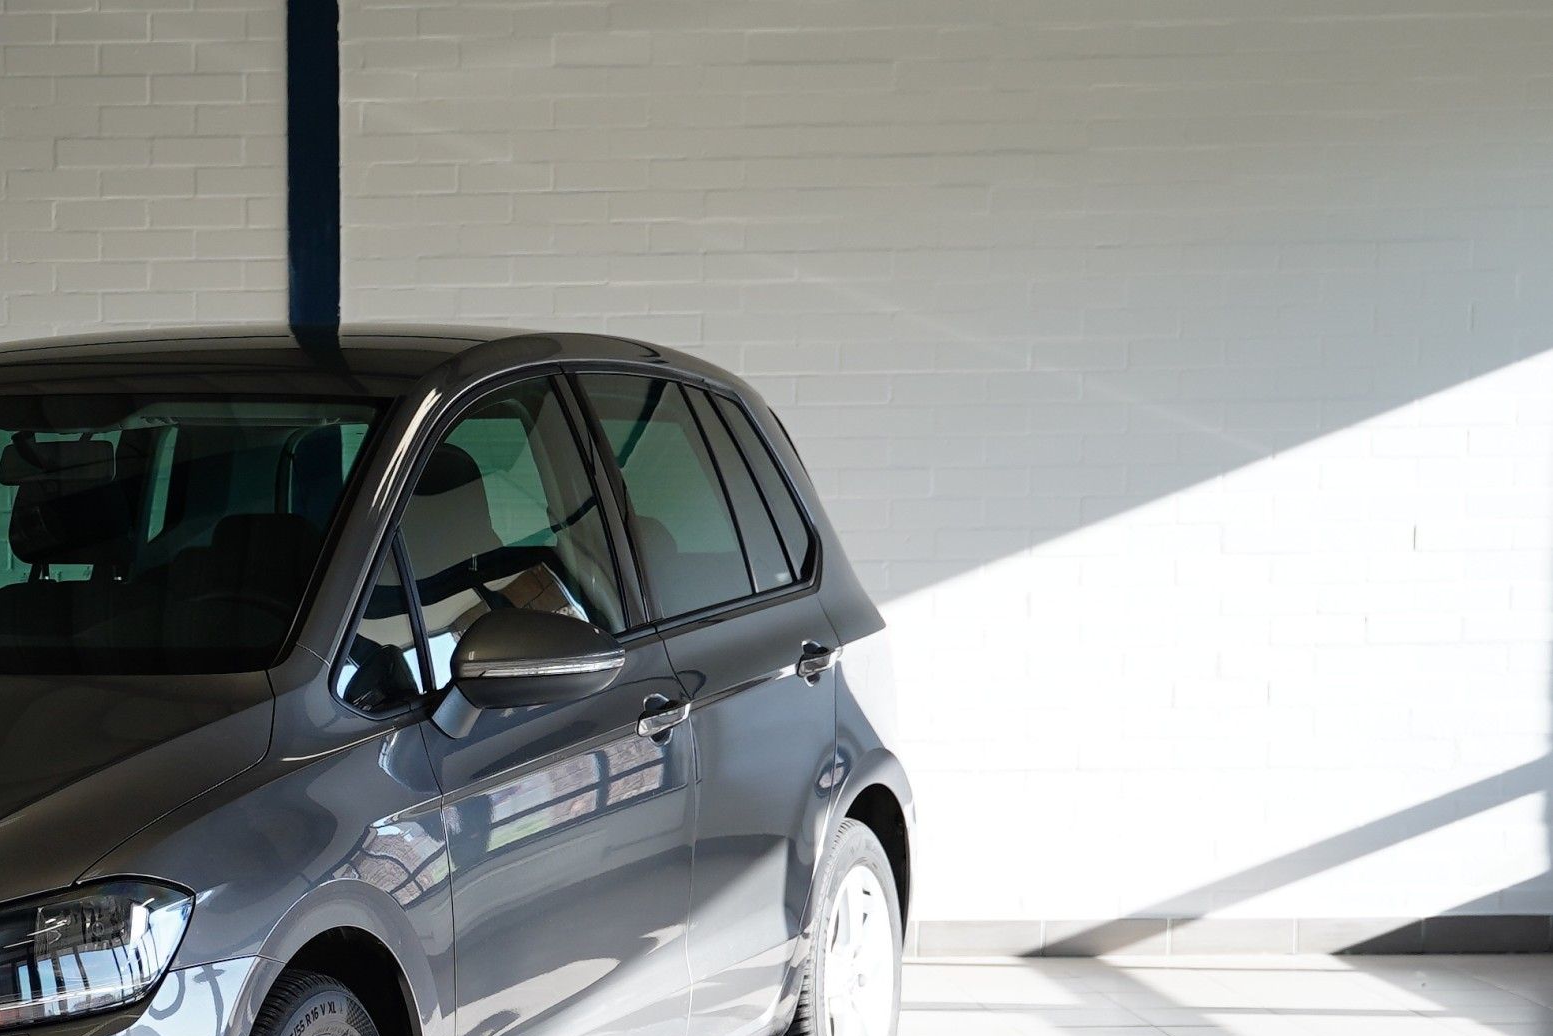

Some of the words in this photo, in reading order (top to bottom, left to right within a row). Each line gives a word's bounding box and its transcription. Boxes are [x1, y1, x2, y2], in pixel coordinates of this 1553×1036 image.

[305, 1013, 313, 1027] R
[312, 1006, 319, 1022] 16
[320, 1003, 326, 1016] V
[327, 1001, 336, 1014] XL
